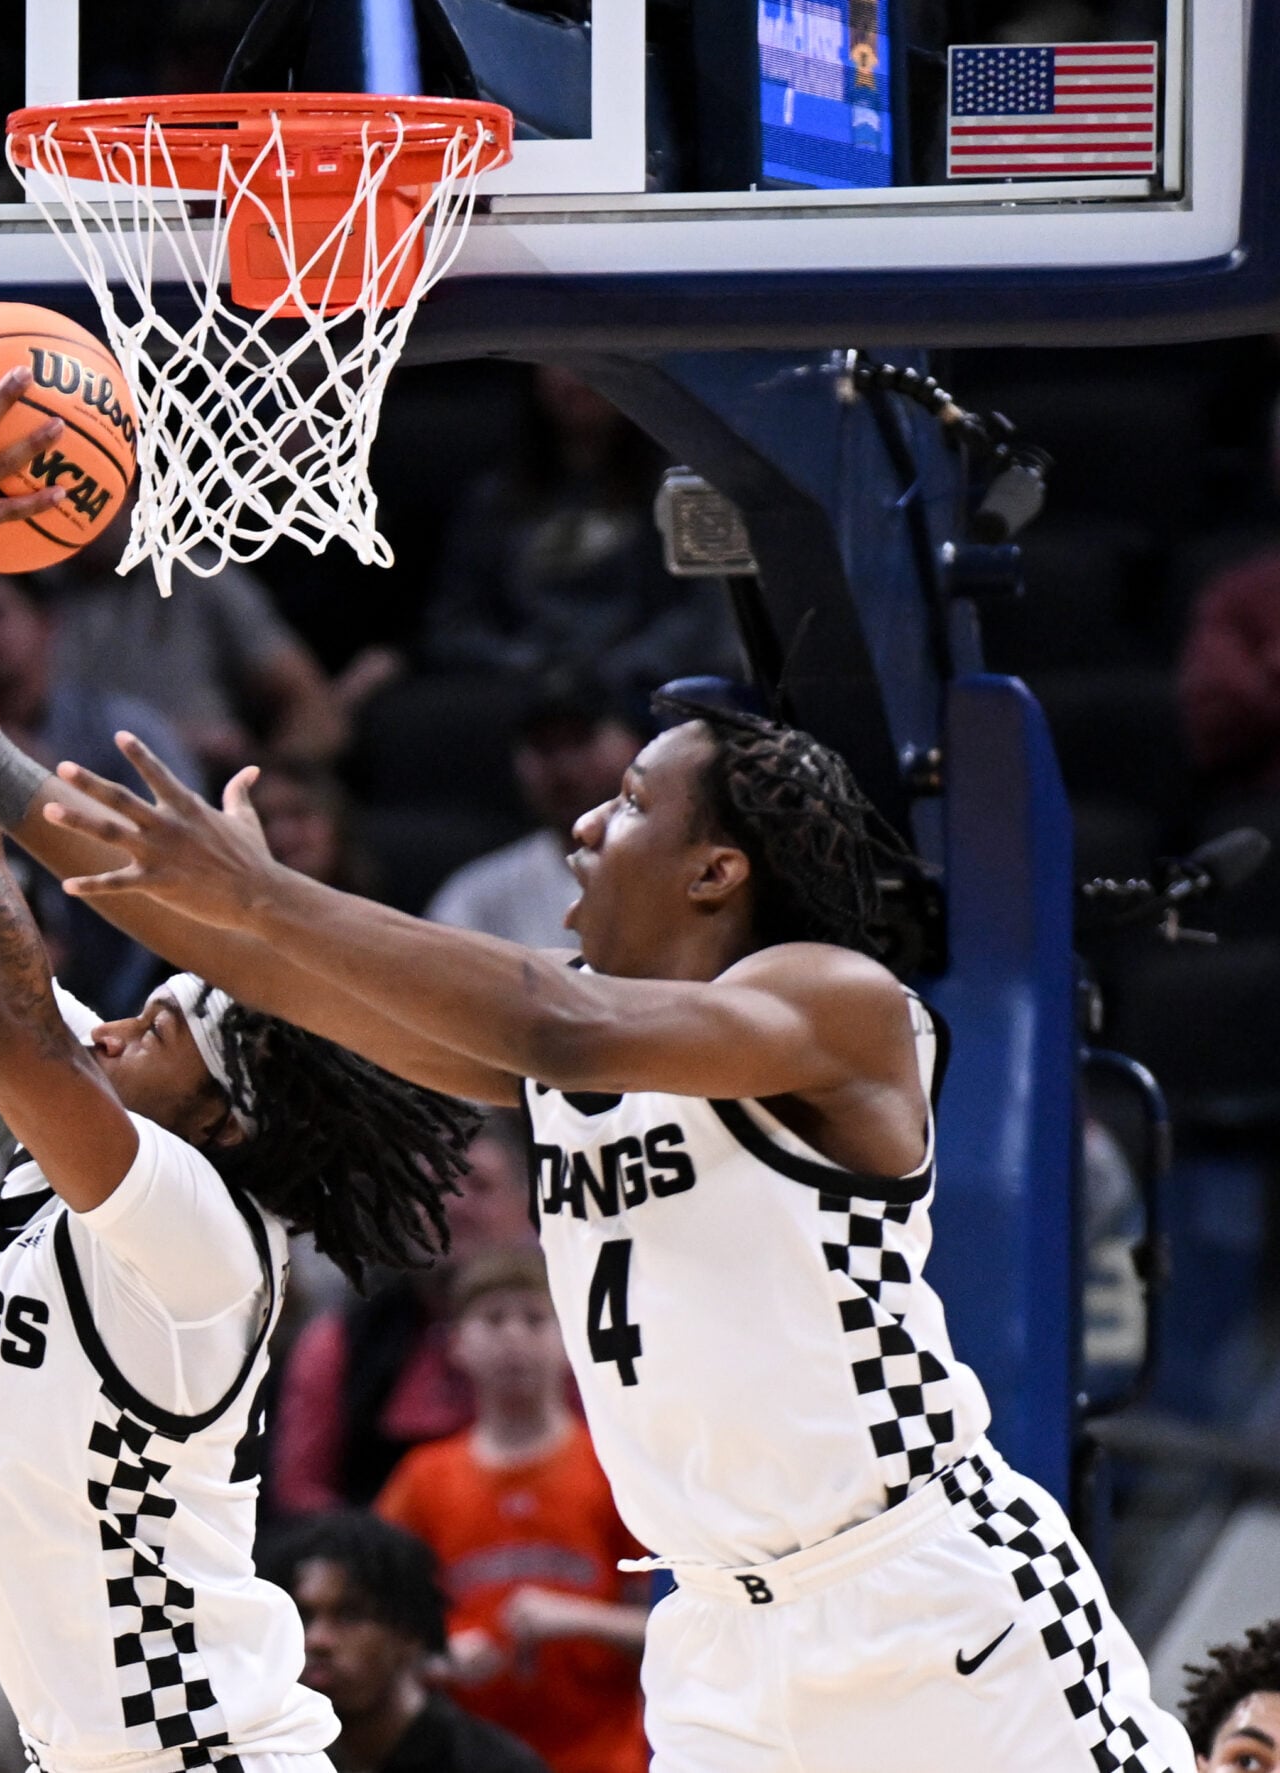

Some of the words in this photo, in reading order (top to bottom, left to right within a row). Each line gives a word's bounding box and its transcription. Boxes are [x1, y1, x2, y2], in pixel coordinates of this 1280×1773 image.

[28, 346, 137, 456] Wilso
[29, 448, 111, 524] NCAA
[586, 1238, 643, 1387] 4
[733, 1574, 774, 1605] B
